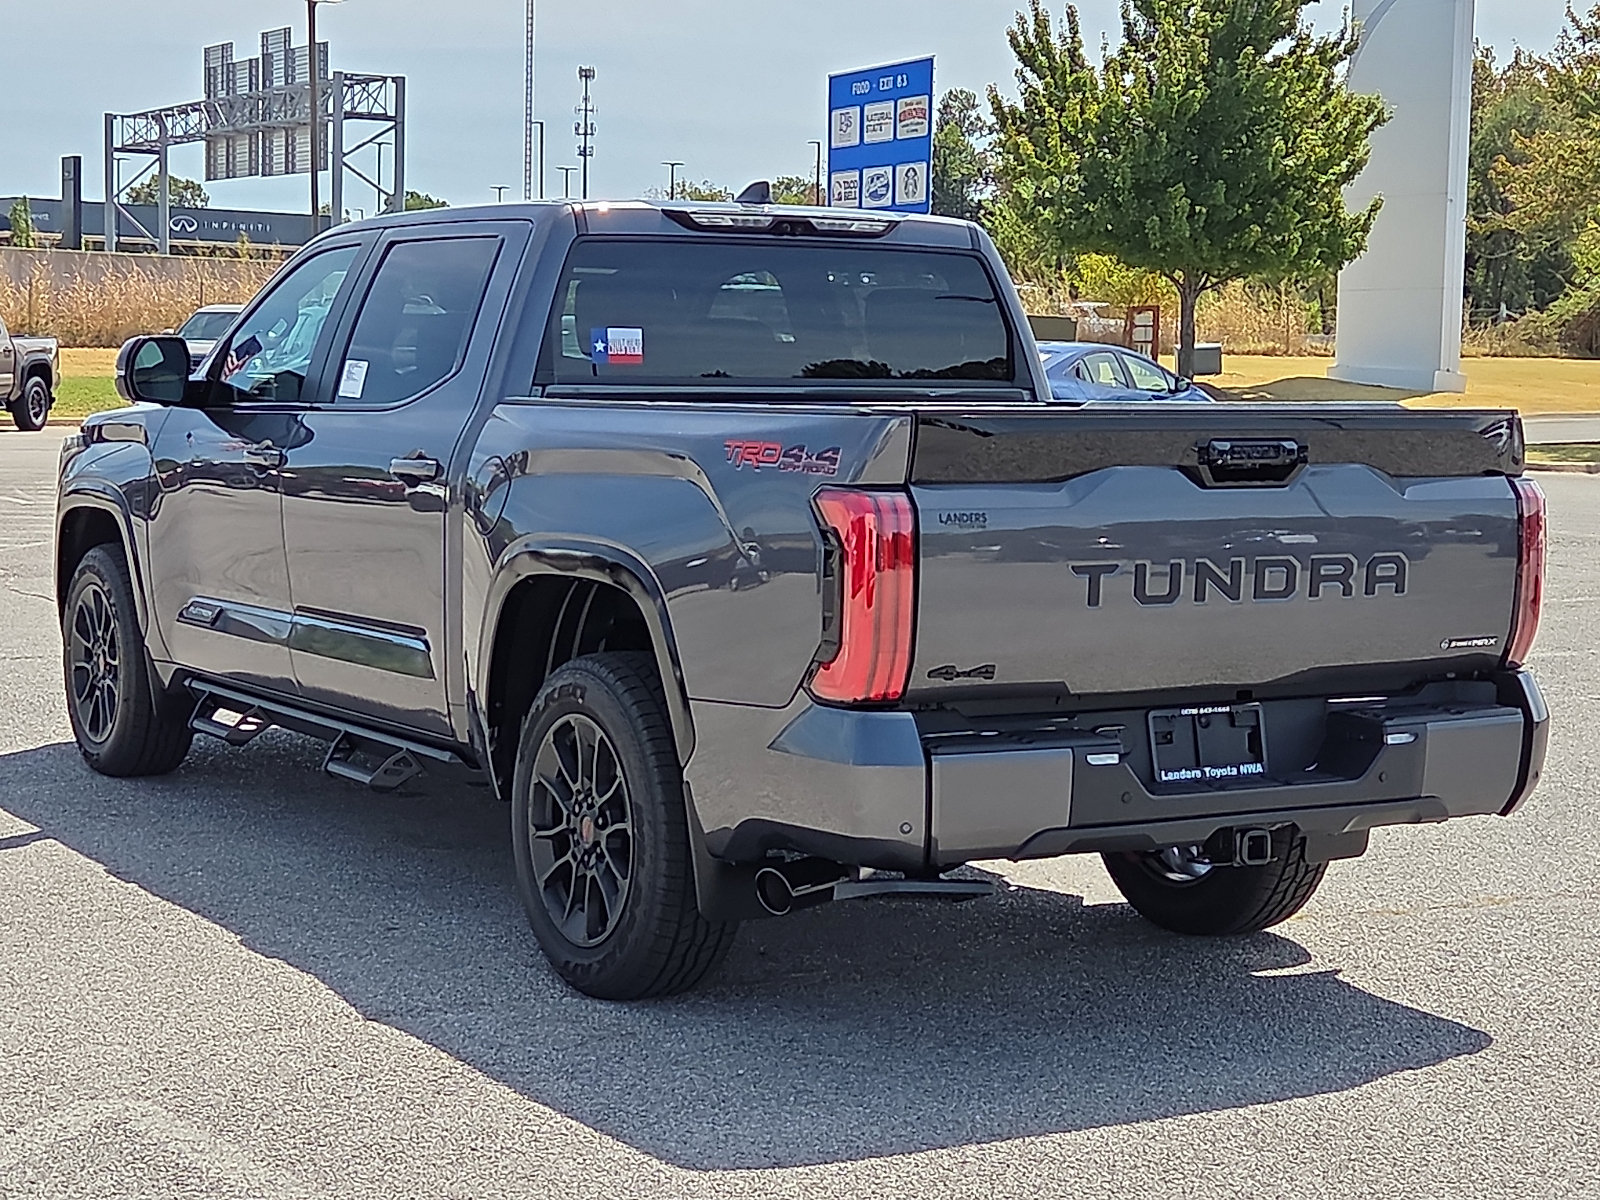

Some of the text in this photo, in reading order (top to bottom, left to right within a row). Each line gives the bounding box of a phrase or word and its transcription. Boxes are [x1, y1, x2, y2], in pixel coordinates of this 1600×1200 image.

[852, 81, 870, 95] FOOD
[880, 76, 894, 91] EXIT
[204, 221, 271, 232] INFINITI
[724, 440, 782, 471] TRD
[939, 512, 987, 525] LANDERS
[1068, 552, 1409, 608] TUNDRA
[1161, 762, 1264, 781] Landers Toyota NWA
